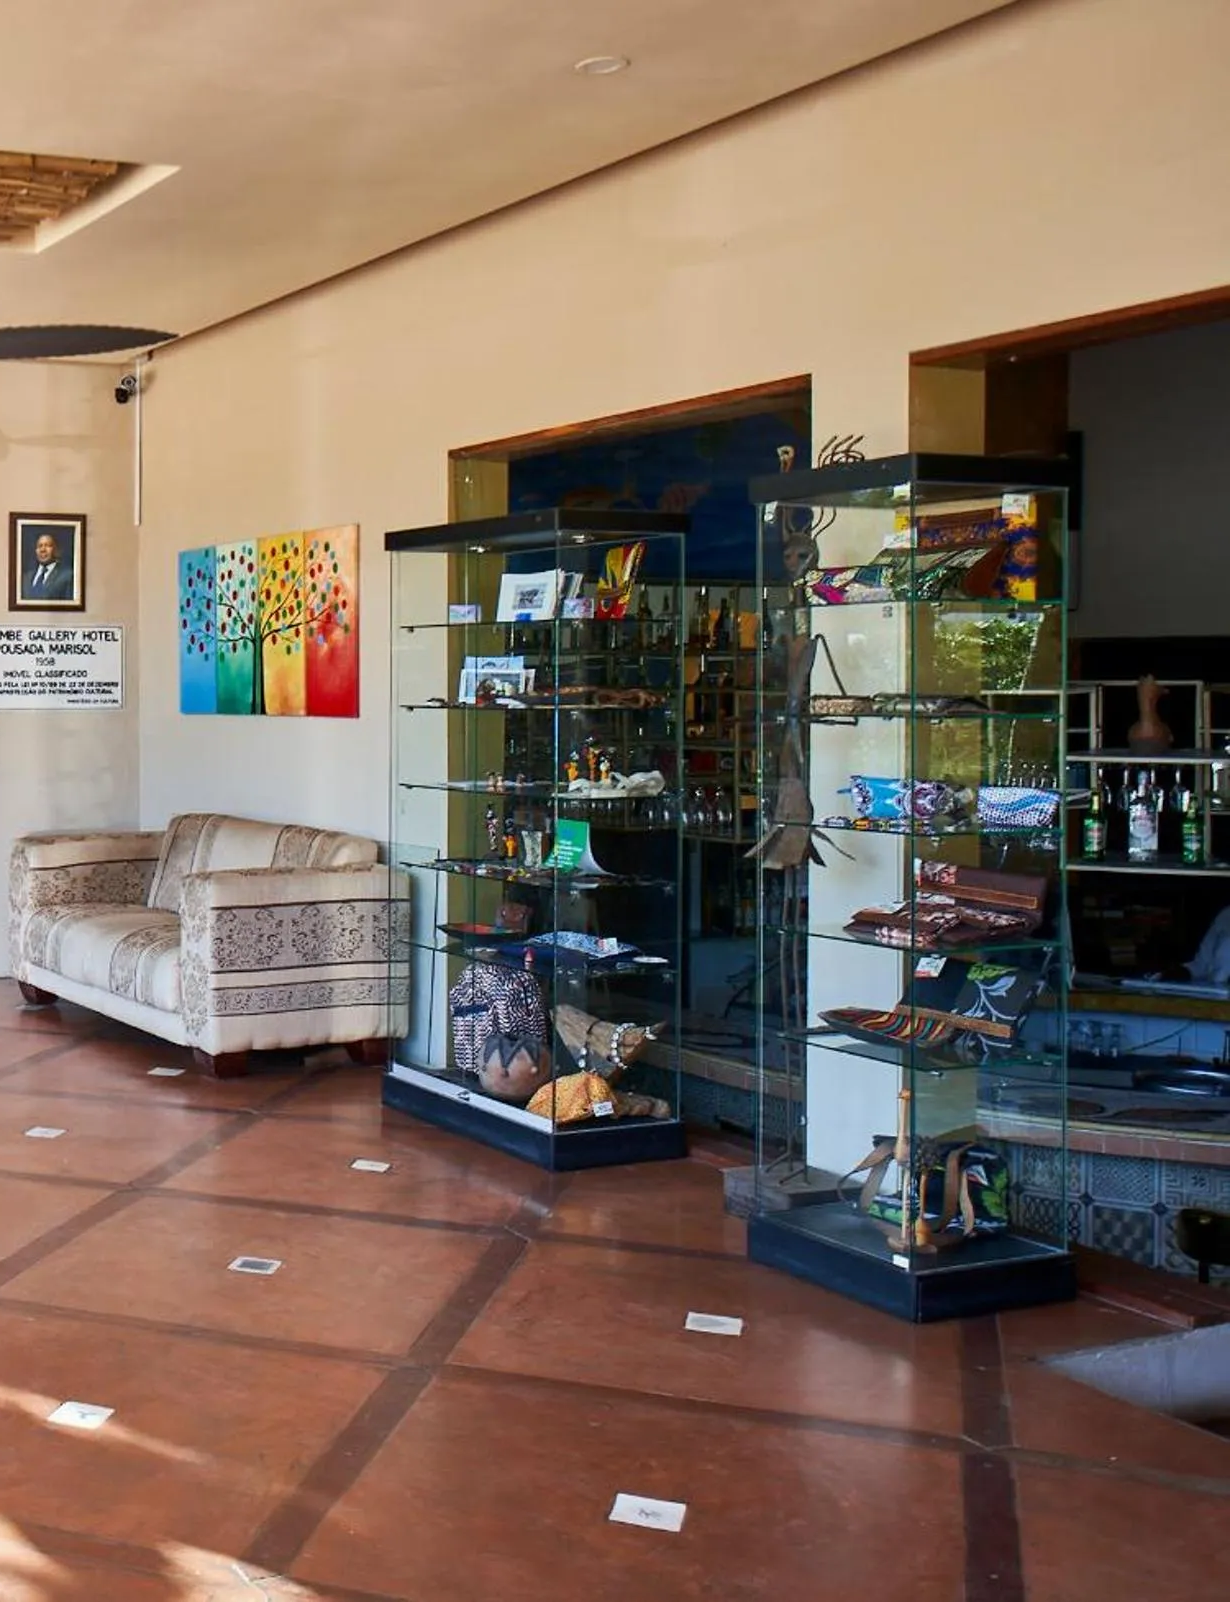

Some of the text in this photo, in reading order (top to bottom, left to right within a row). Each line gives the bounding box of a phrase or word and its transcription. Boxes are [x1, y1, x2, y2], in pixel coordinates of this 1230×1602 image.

[28, 629, 77, 641] GALLERY
[82, 630, 119, 642] HOTEL
[49, 643, 96, 655] MARISOL
[35, 656, 56, 667] 1958
[34, 670, 88, 678] CLASSIFICADO
